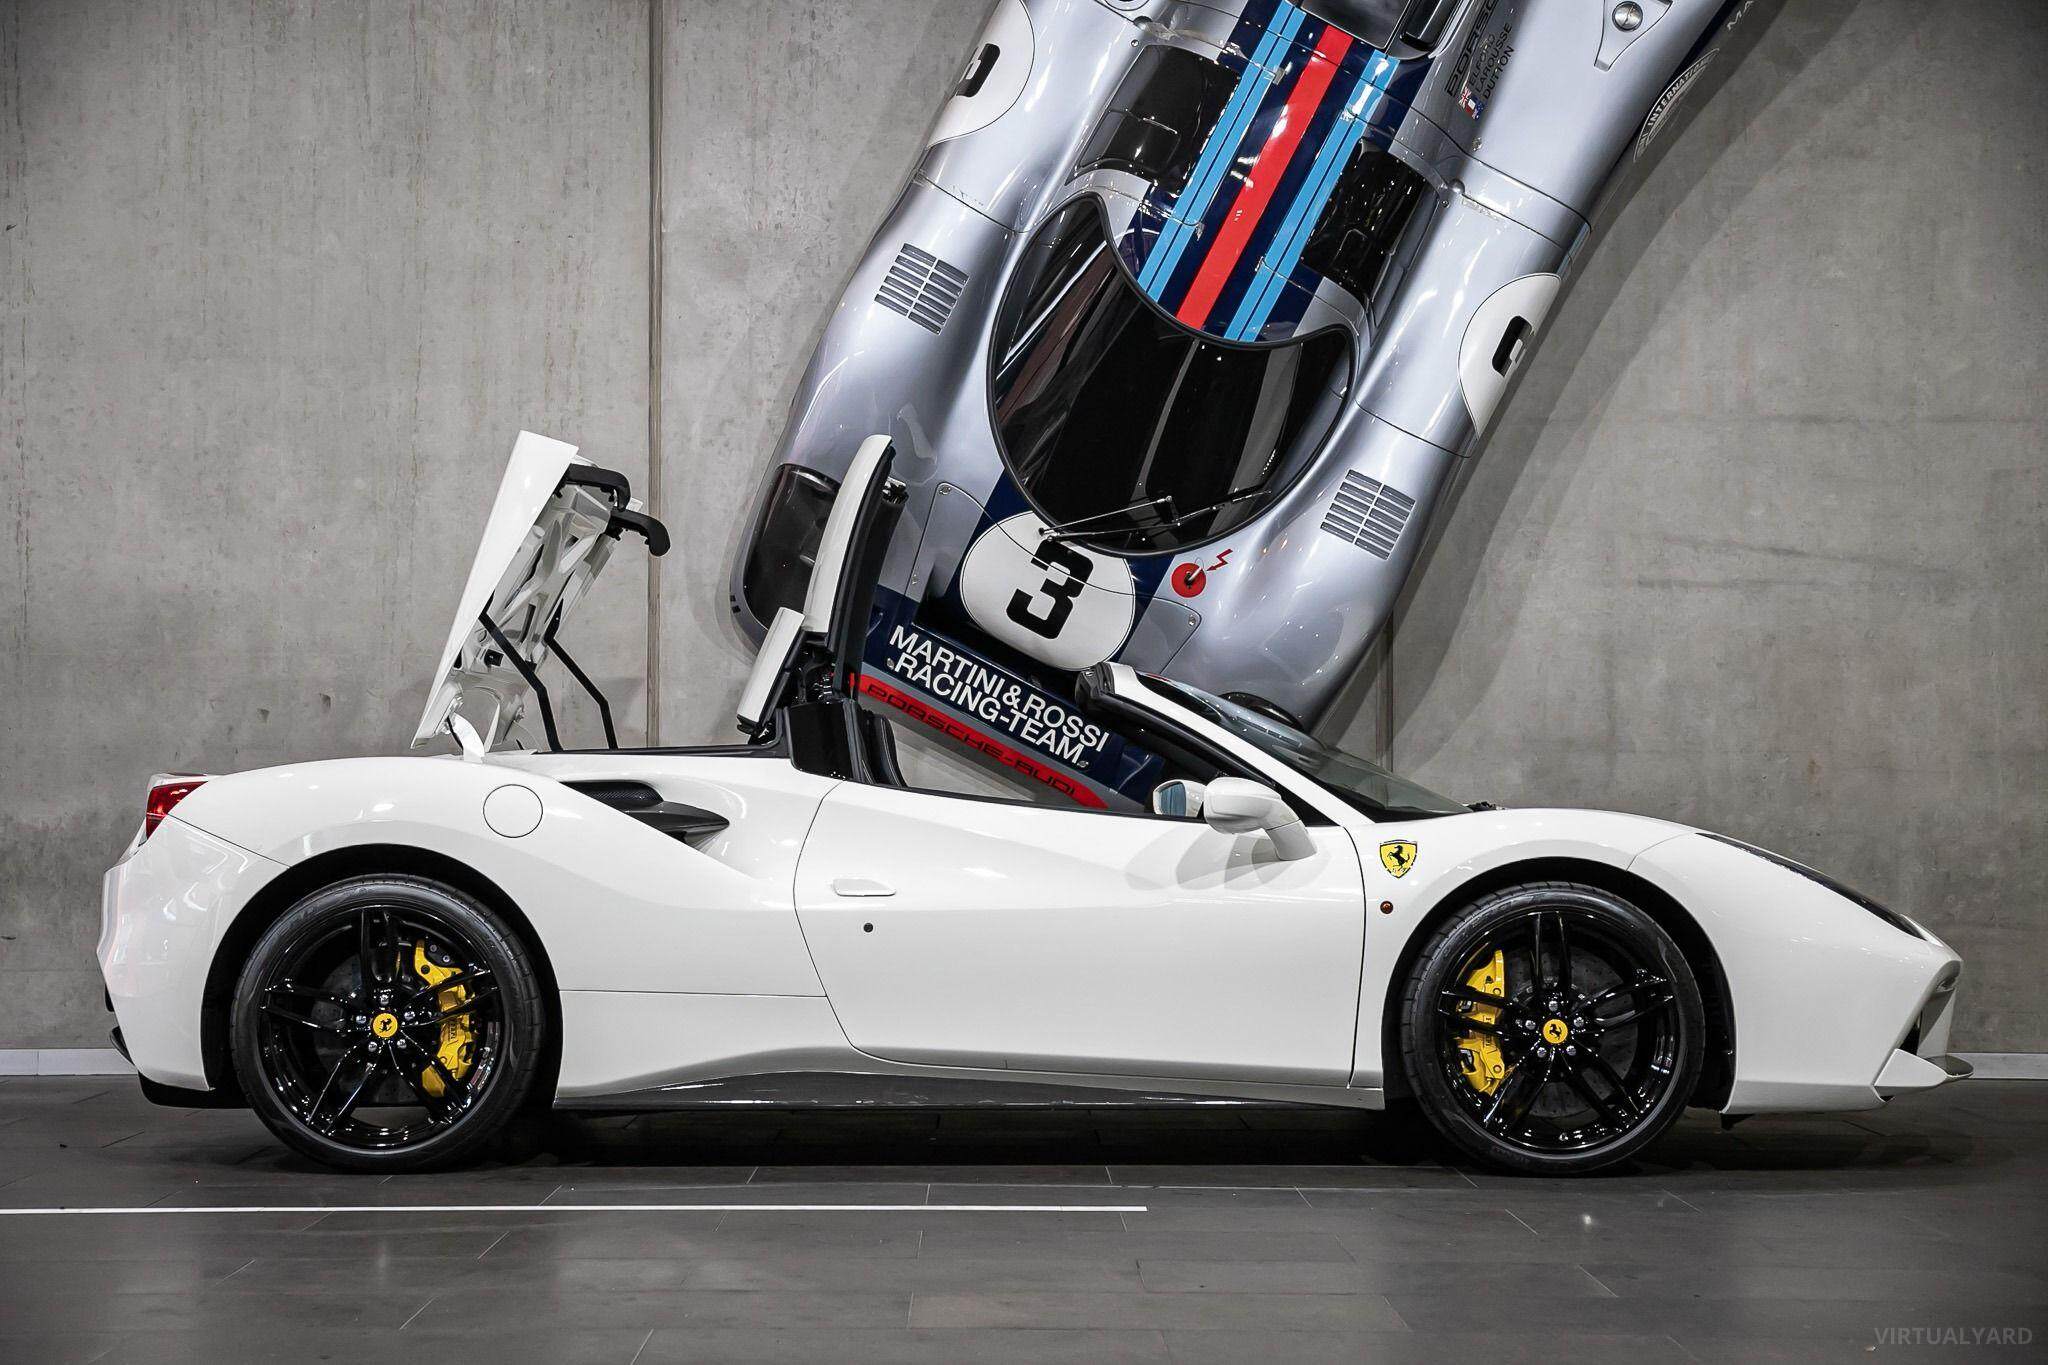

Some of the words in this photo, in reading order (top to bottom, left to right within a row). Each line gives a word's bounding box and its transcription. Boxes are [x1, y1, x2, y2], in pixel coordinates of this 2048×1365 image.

[1475, 22, 1512, 93] LAROUSSE
[1482, 45, 1515, 100] DUTTON
[1006, 538, 1094, 640] 3
[867, 684, 1077, 797] PORSCHE-AUDI
[889, 625, 1005, 699] MARTINI
[1002, 684, 1023, 707] &
[1023, 696, 1110, 753] ROSSI
[894, 657, 1086, 765] RACING-TEAM
